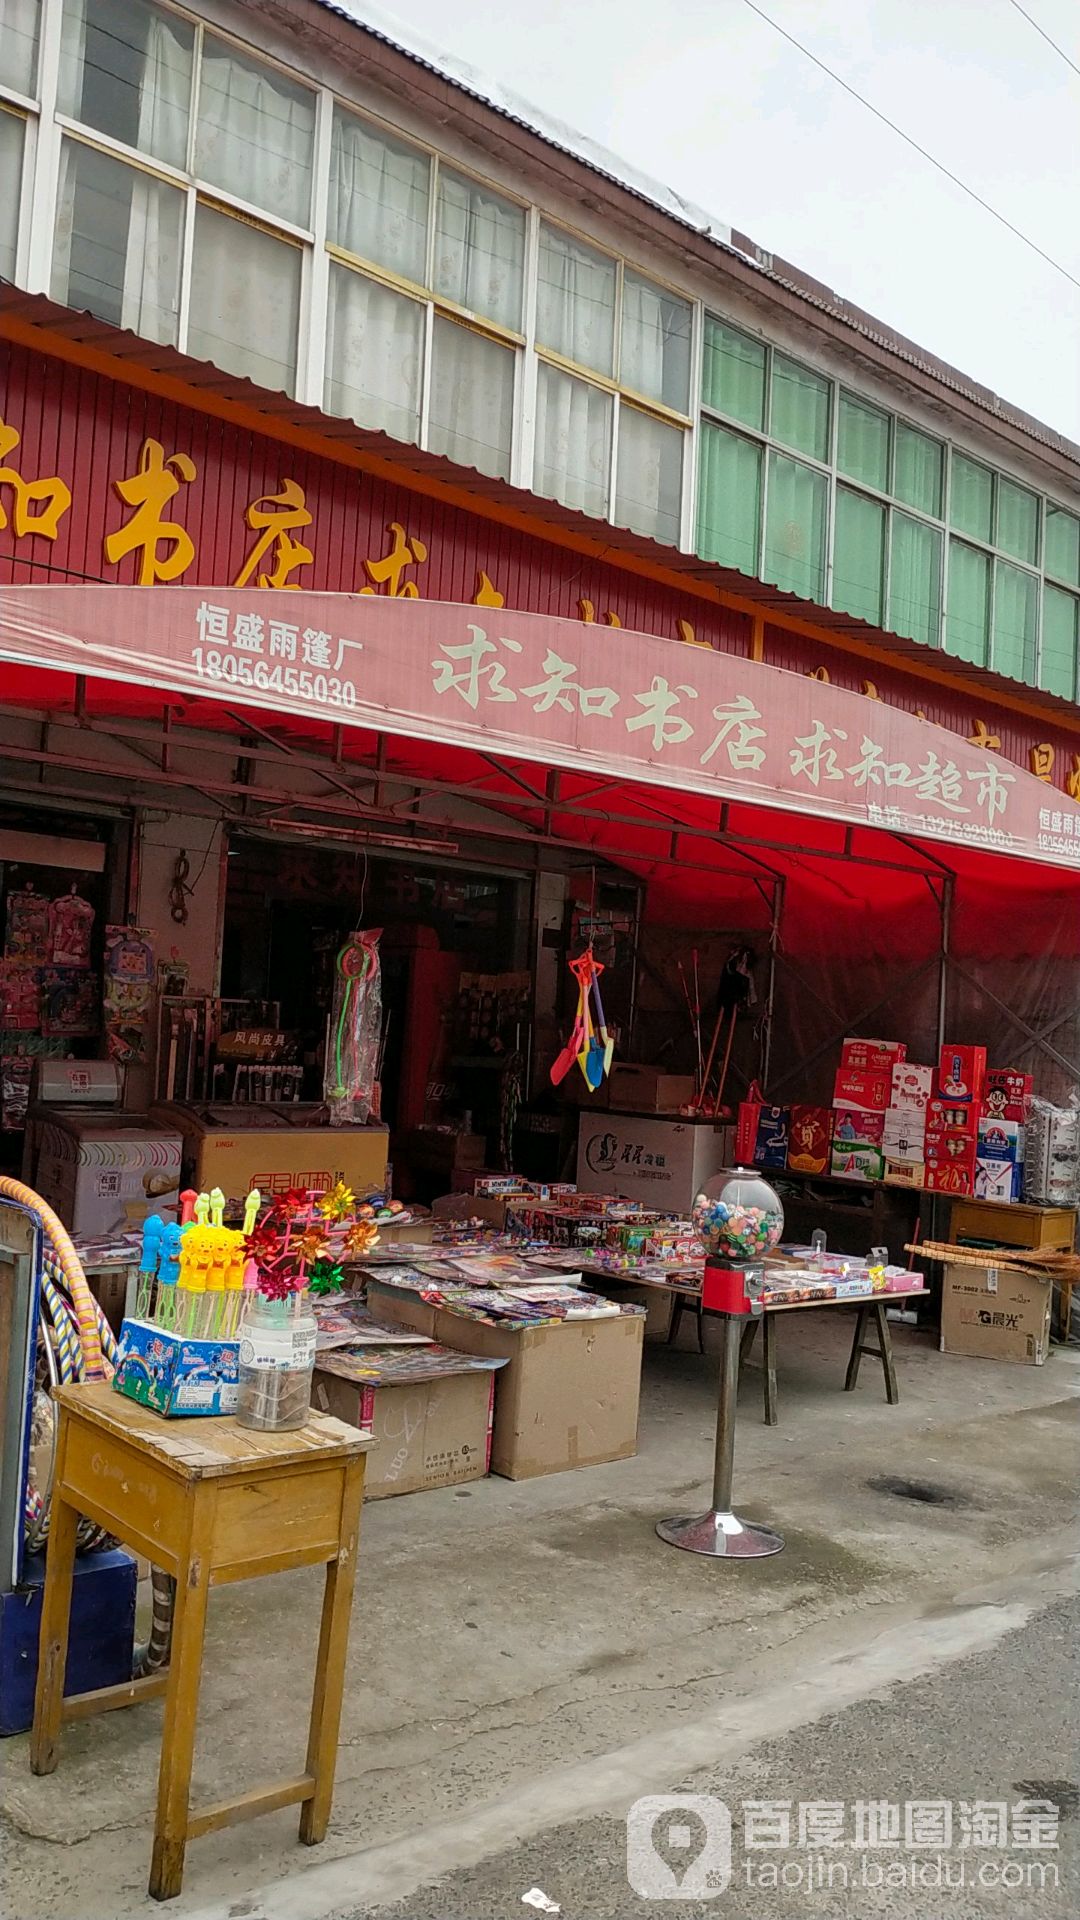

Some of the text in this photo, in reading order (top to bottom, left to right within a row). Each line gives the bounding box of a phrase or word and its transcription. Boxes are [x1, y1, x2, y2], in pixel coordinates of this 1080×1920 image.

[191, 647, 356, 708] 18056455030
[196, 602, 363, 671] 恒盛雨篷厂
[431, 624, 769, 772] 求知书店
[788, 720, 1017, 826] 求知超市
